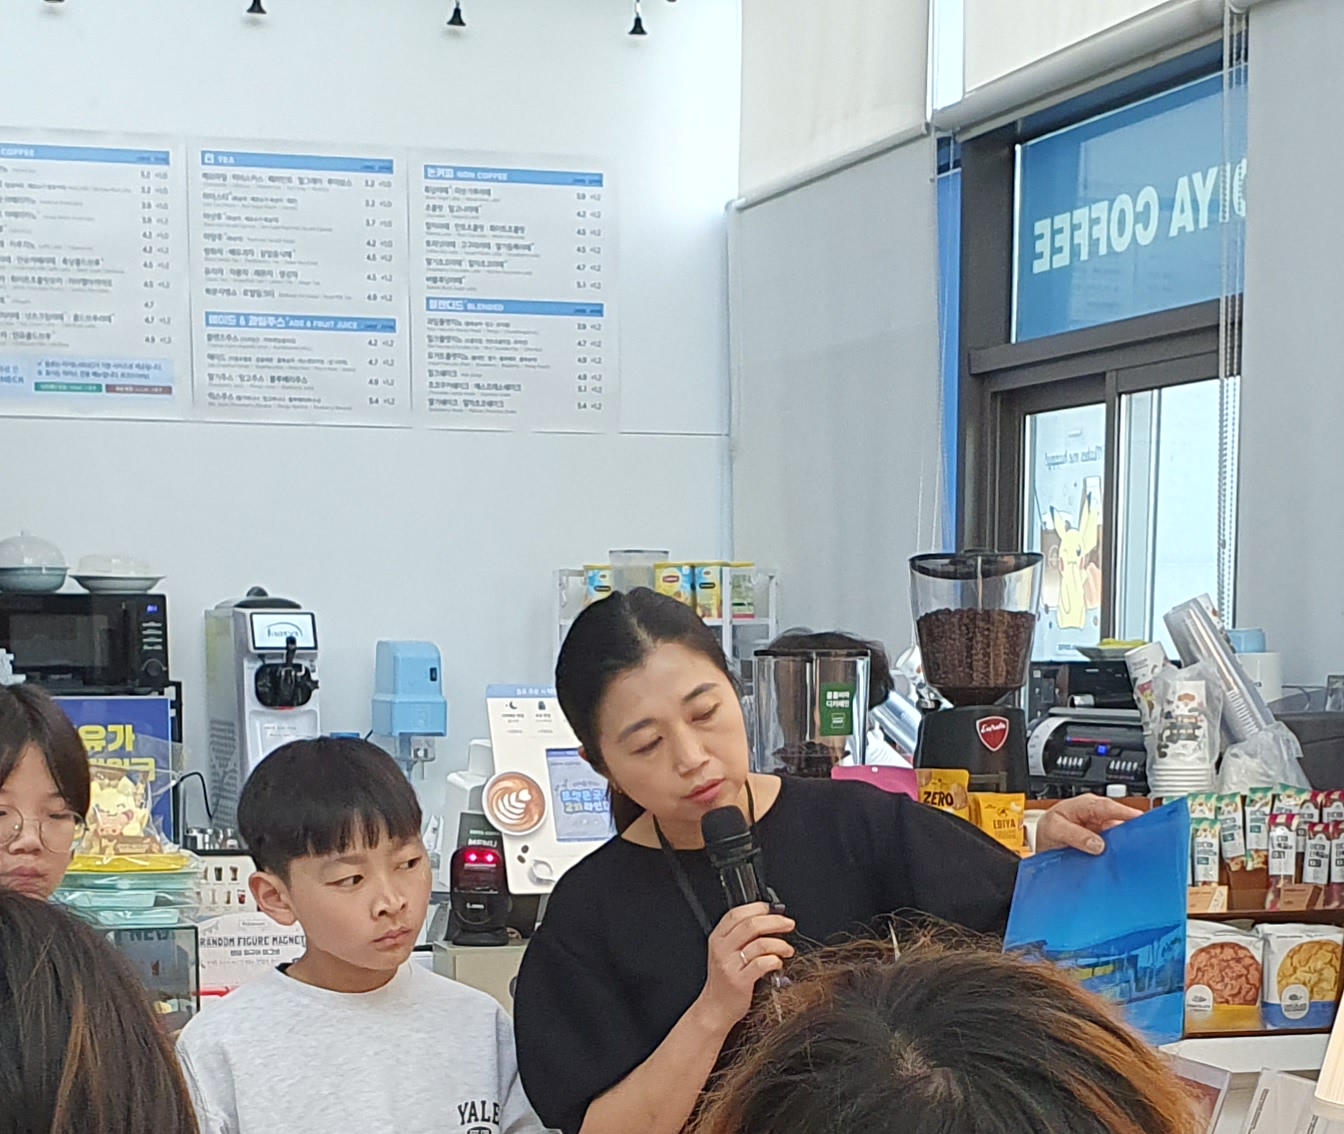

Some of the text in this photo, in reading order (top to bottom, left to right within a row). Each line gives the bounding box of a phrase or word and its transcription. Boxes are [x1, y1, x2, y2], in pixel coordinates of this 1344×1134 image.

[0, 148, 34, 156] COFFEE
[923, 791, 954, 806] ZERO
[200, 935, 305, 947] RANDOM FIGURE MAGNET
[458, 1100, 499, 1126] YALE
